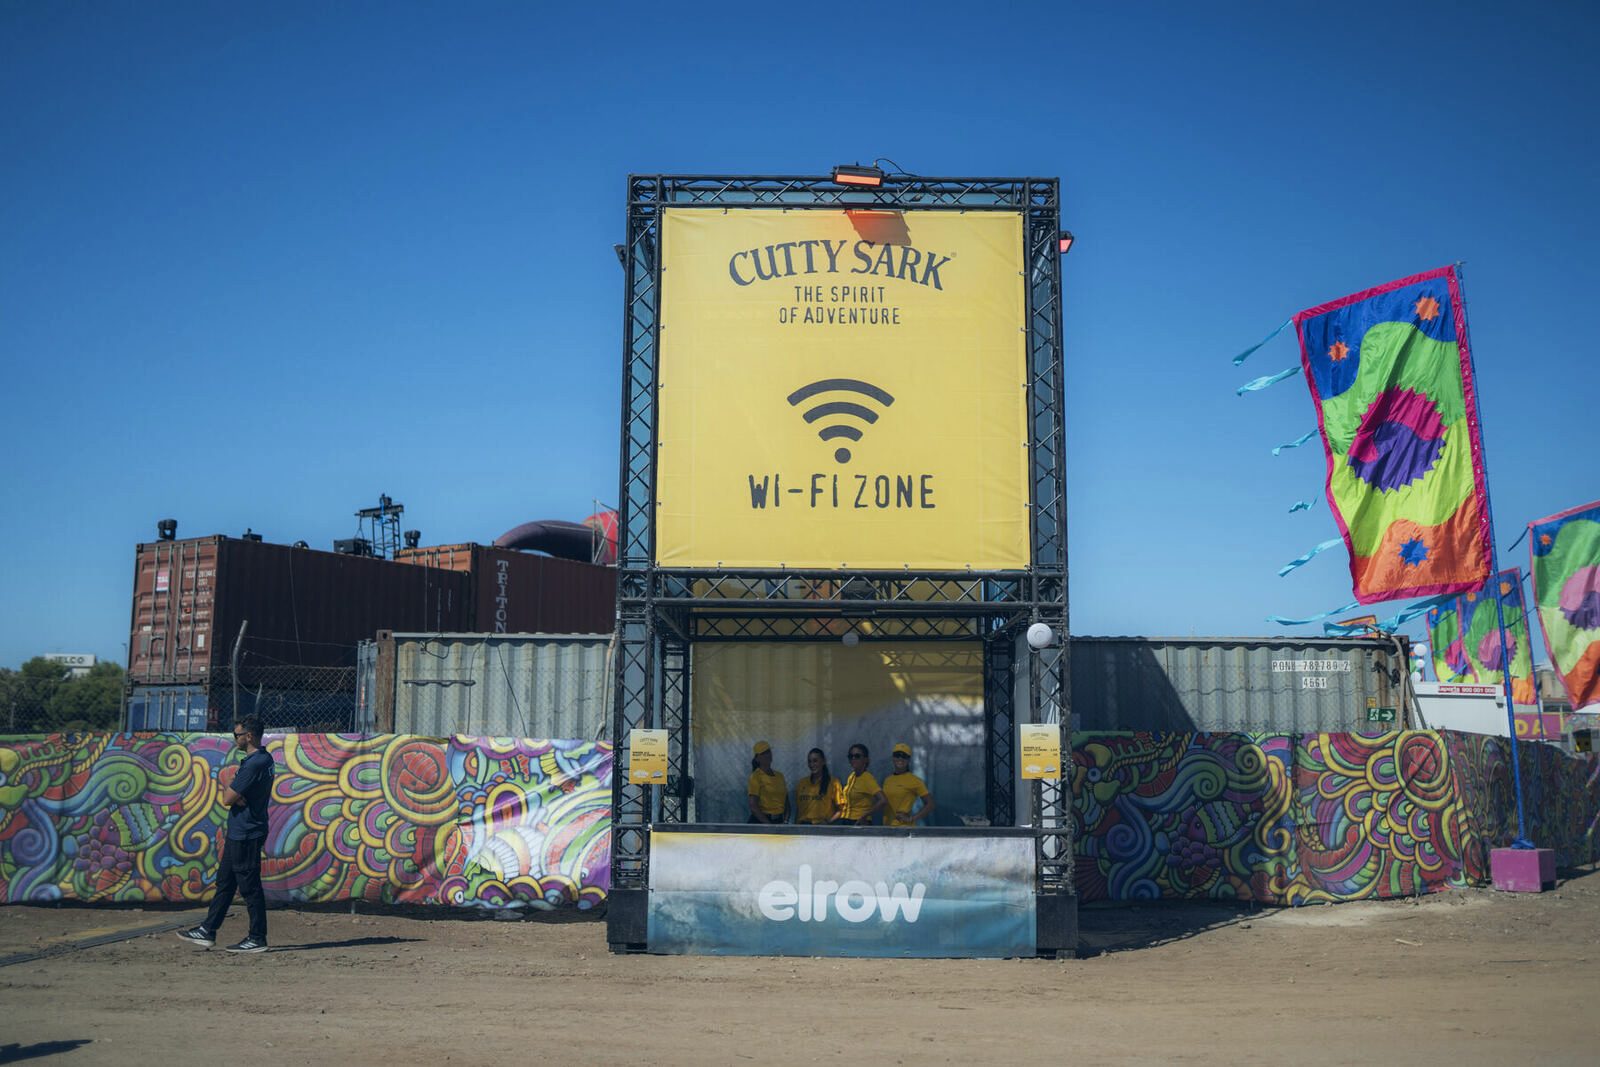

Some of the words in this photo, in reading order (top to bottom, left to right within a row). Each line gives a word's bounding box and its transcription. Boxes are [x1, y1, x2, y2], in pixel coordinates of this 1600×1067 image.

[729, 239, 847, 286] CUTTY
[850, 239, 951, 291] SARK
[779, 307, 798, 324] OF
[804, 307, 901, 325] ADVENTURE
[794, 285, 824, 303] THE
[830, 286, 886, 304] SPIRIT
[748, 473, 838, 509] WI-FI
[854, 474, 936, 509] ZONE
[495, 559, 509, 633] TRITON
[758, 863, 927, 924] elrow
